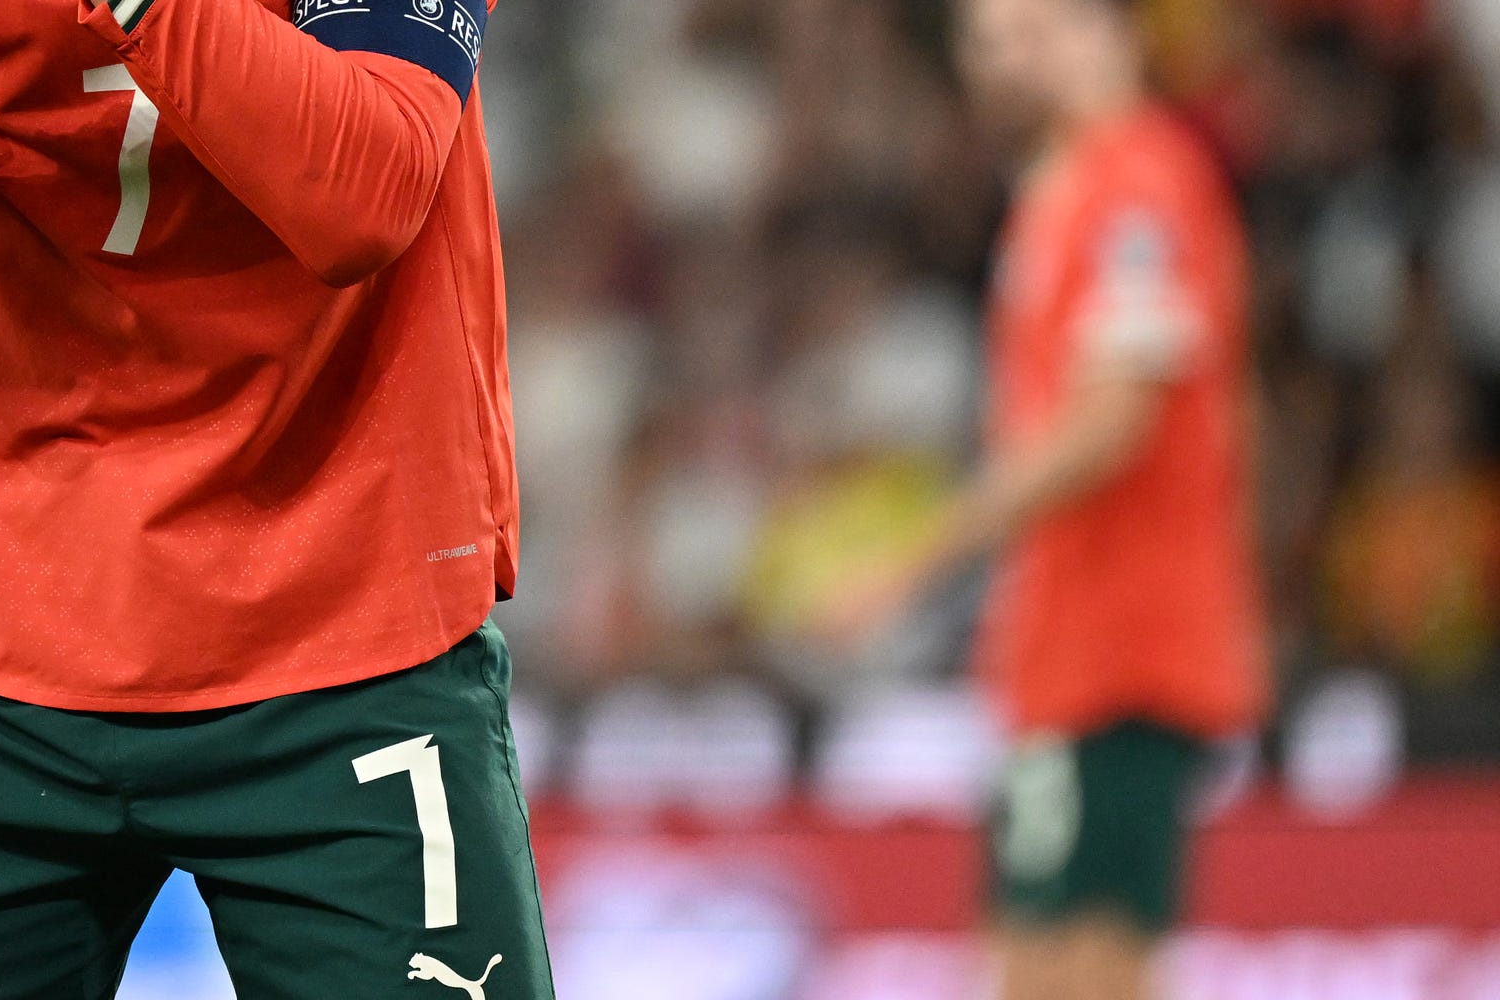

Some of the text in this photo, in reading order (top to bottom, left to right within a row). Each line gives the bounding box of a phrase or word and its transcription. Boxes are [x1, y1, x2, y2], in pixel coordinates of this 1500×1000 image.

[451, 9, 480, 66] RES
[82, 63, 160, 256] 7
[351, 733, 457, 928] 7
